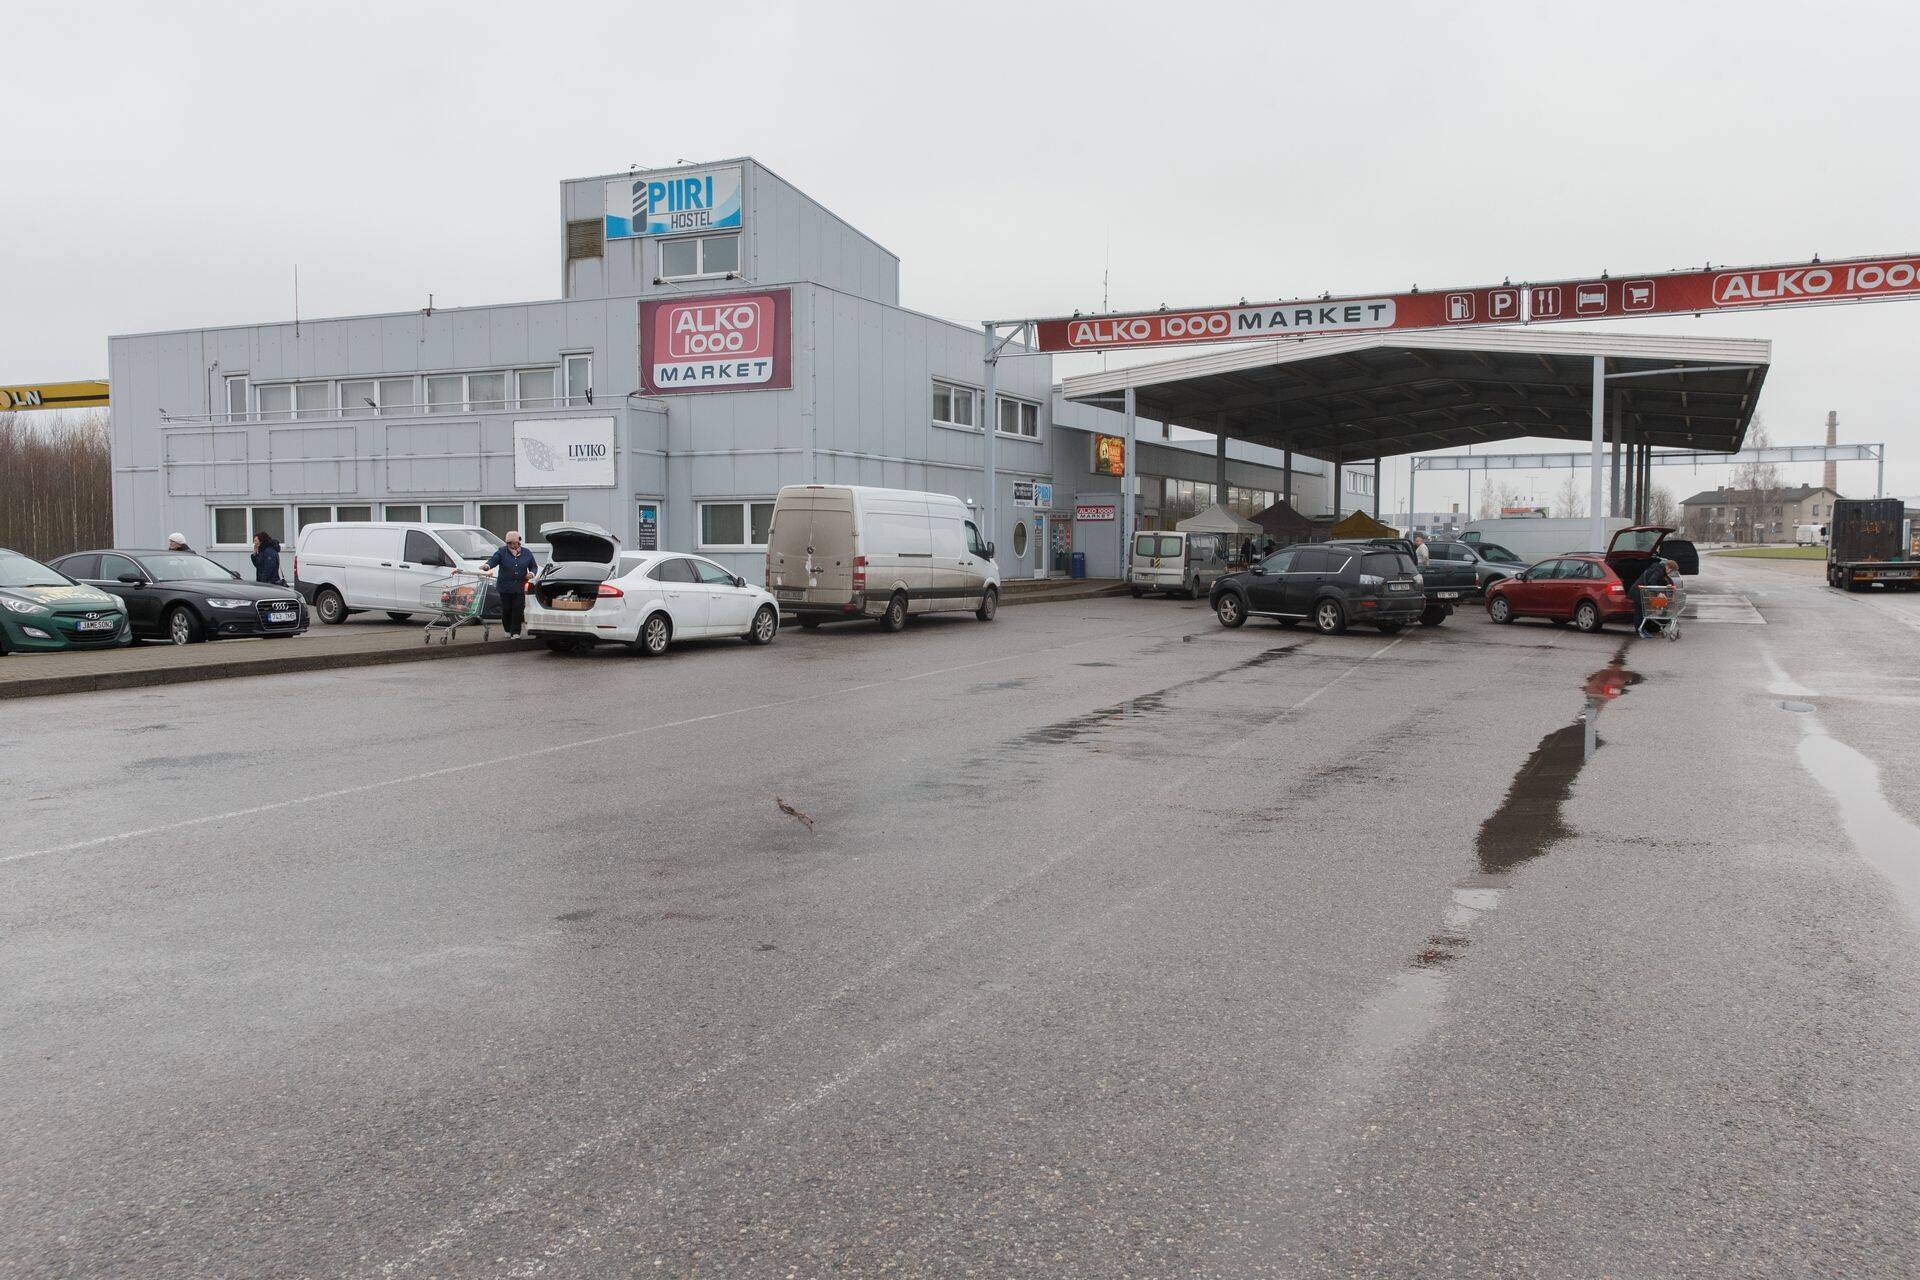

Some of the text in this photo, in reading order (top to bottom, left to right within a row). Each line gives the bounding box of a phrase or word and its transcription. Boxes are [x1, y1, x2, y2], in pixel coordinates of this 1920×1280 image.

[648, 176, 713, 213] PIIRI
[671, 210, 713, 229] HOSTEL
[1721, 264, 1920, 300] ALKO 100
[675, 306, 755, 333] ALKO
[1074, 304, 1387, 343] ALKO 1000 MARKET
[684, 331, 744, 354] 1000
[660, 361, 768, 382] MARKET
[568, 444, 606, 457] LIVIKO
[83, 620, 113, 630] JAMESON2
